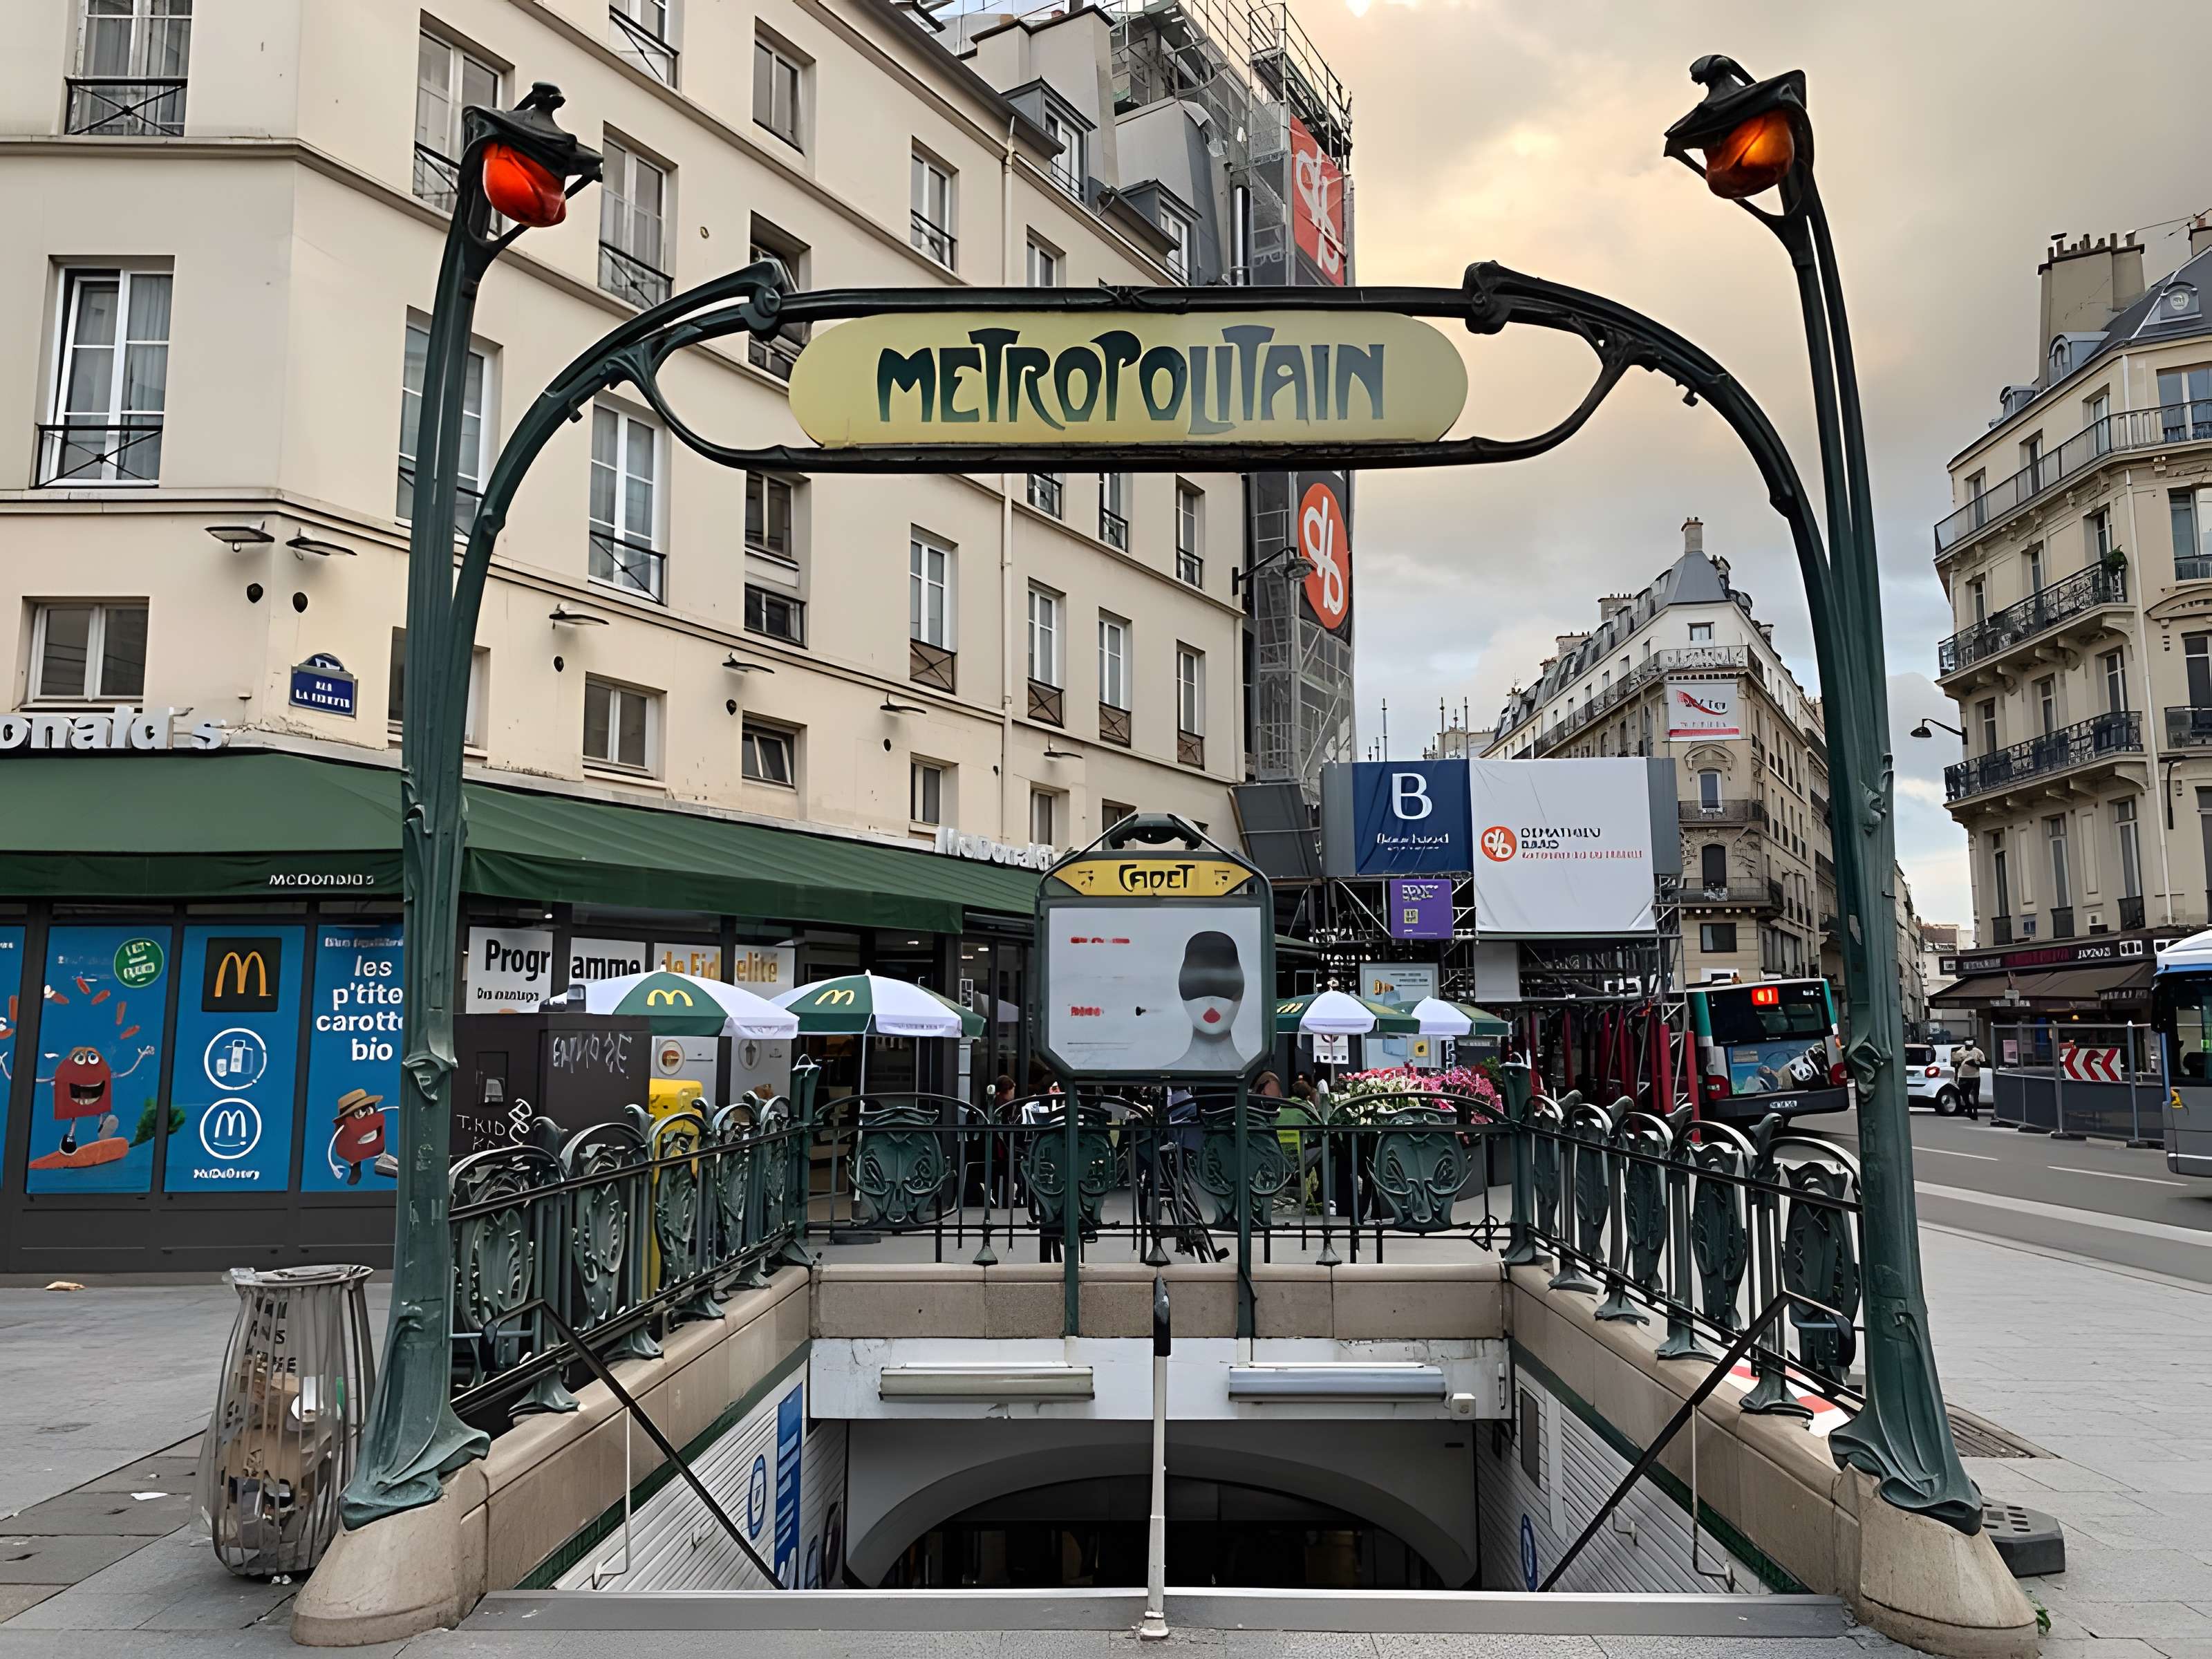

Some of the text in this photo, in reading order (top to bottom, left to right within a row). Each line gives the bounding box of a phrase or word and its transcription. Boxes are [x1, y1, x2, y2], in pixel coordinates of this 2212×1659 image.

[877, 325, 1385, 435] METROPOLITAIN
[1391, 773, 1433, 820] B
[1118, 863, 1195, 892] CADET
[354, 955, 393, 977] les
[351, 1036, 393, 1061] bio
